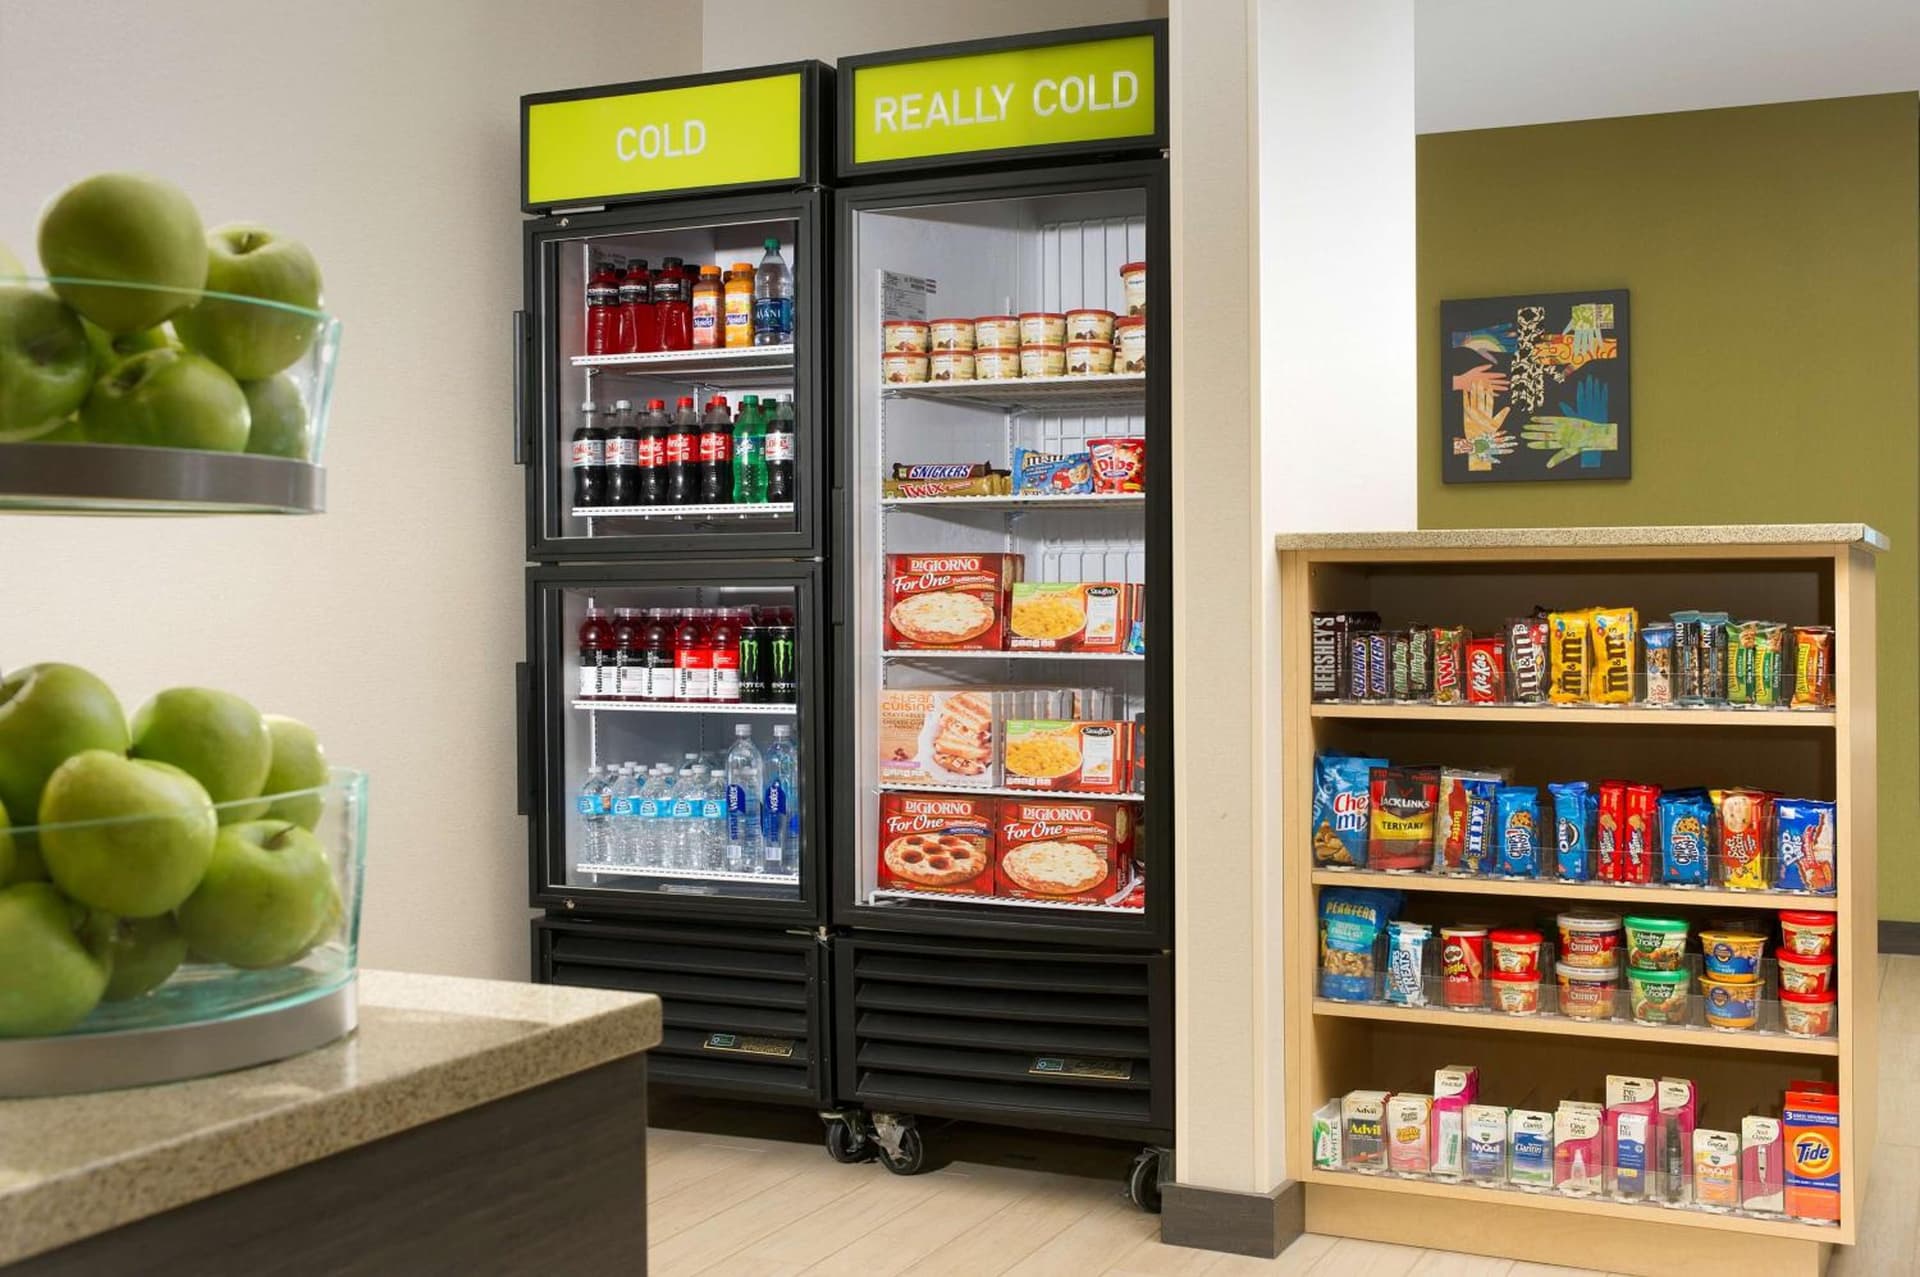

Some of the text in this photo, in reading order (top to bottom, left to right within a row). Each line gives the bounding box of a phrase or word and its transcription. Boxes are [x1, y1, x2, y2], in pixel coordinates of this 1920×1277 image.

[873, 69, 1138, 134] REALLY COLD
[615, 119, 707, 162] COLD
[911, 465, 971, 478] SNICKERS
[892, 575, 919, 593] For
[918, 572, 951, 589] One
[1675, 622, 1685, 647] KIND
[1702, 623, 1712, 649] KIND
[1314, 616, 1336, 692] HERSHEY'S
[1371, 635, 1386, 694] SNICKERS
[882, 702, 935, 712] cuisine
[887, 816, 914, 833] For
[912, 815, 945, 832] One
[1004, 823, 1032, 841] For
[1031, 821, 1064, 838] One
[1382, 821, 1424, 831] TERIYAKI
[1451, 810, 1463, 842] Butter
[1470, 806, 1484, 833] ACT
[1559, 817, 1570, 853] OREO
[1399, 950, 1420, 994] TREATS
[1786, 1111, 1793, 1121] 3
[1330, 1120, 1338, 1163] WHITE
[1350, 1122, 1382, 1136] Advil
[1796, 1142, 1830, 1164] Tide
